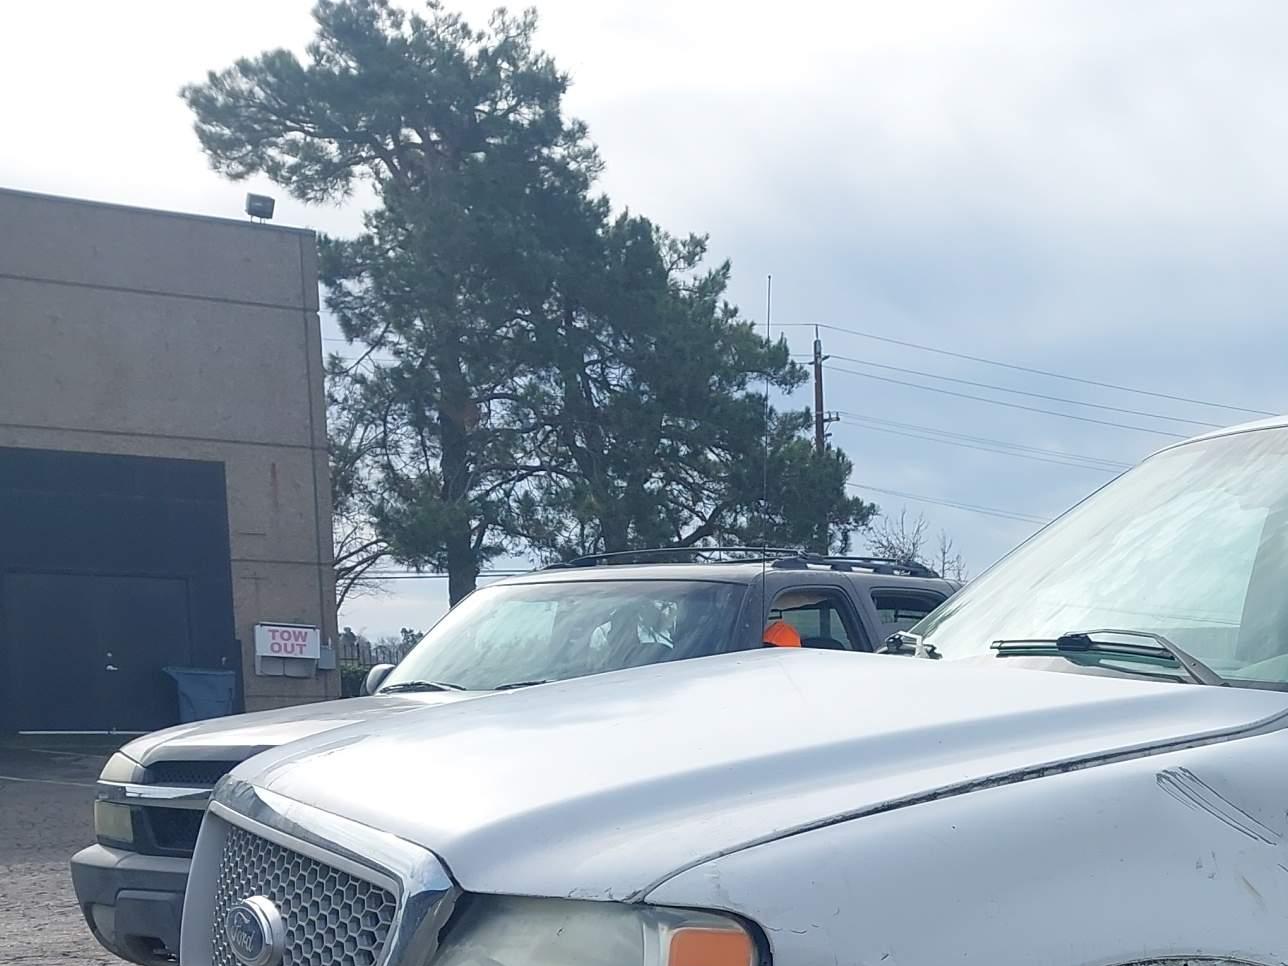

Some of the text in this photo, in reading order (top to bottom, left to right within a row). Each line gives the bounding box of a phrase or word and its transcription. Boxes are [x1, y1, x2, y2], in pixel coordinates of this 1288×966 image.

[268, 629, 308, 642] TOW
[270, 642, 306, 655] OUT
[229, 911, 256, 953] Ford
